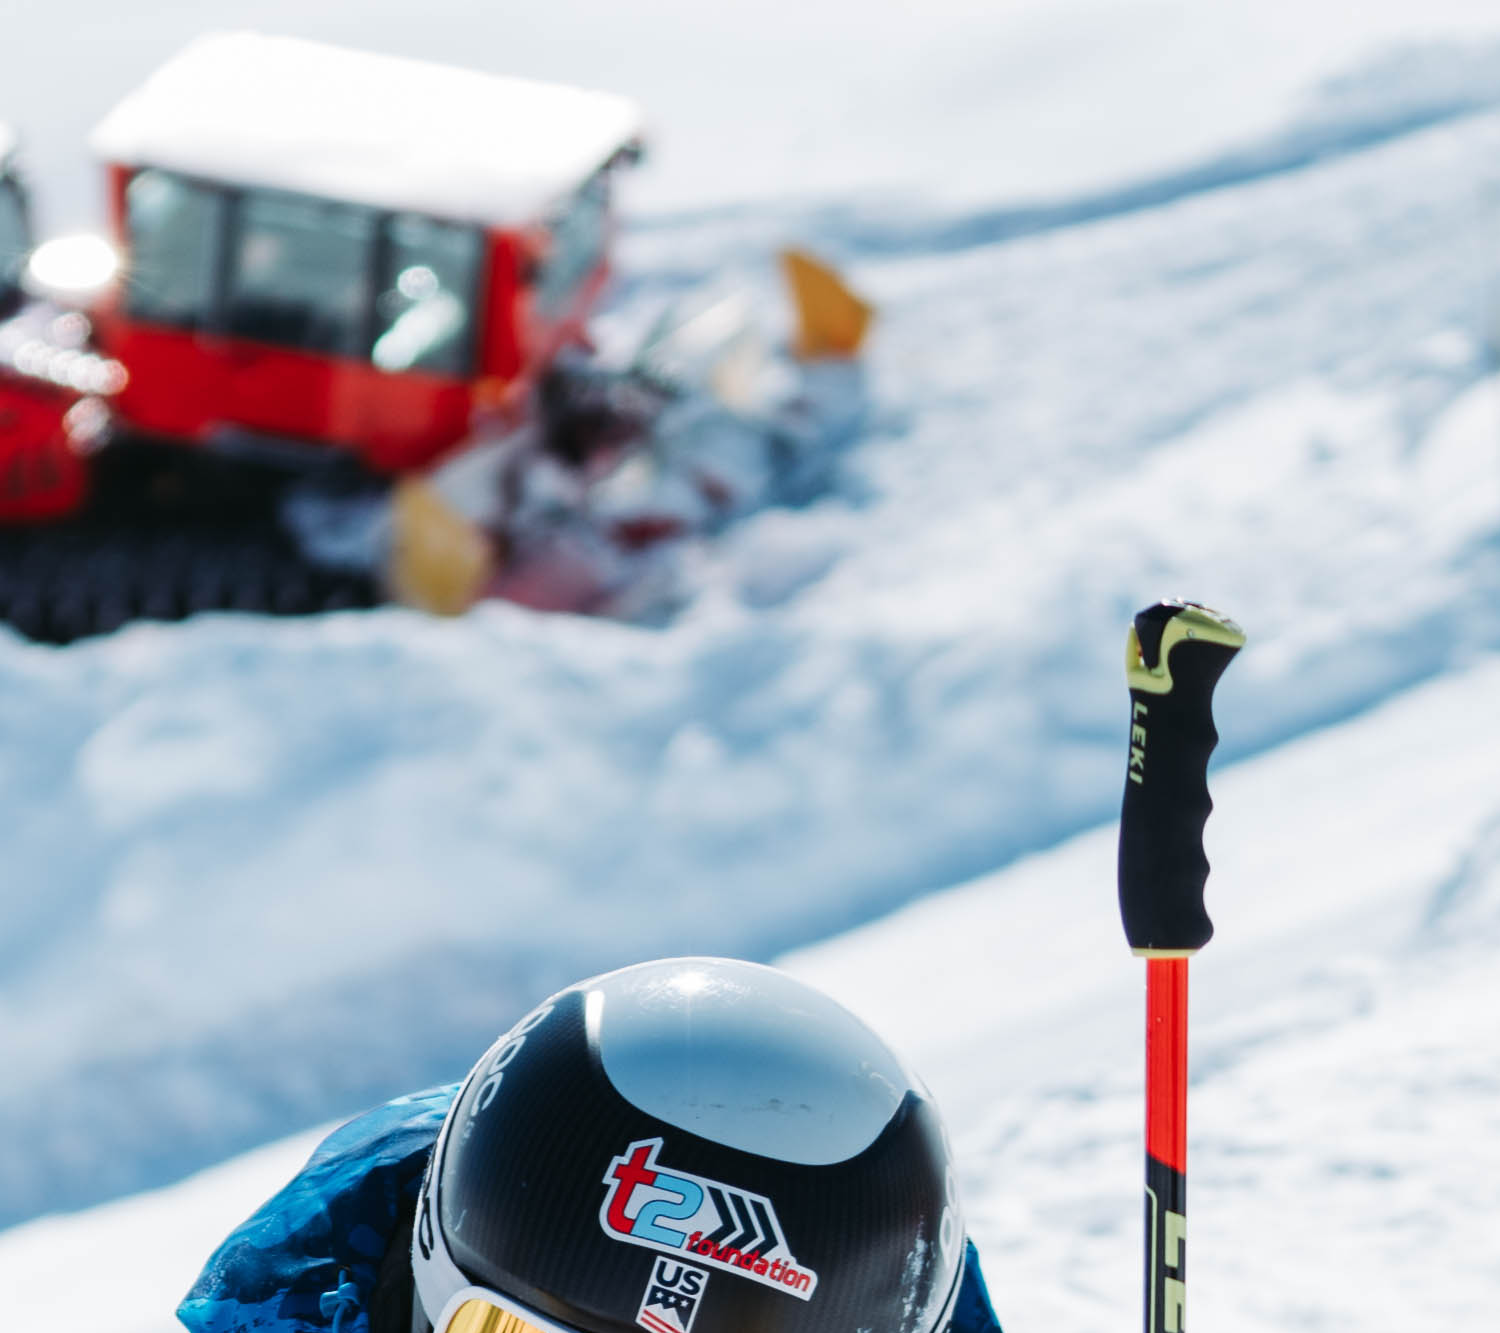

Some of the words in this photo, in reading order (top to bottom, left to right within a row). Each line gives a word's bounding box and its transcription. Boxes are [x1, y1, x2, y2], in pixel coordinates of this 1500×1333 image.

[1129, 700, 1149, 785] LEKI
[606, 1145, 704, 1249] t2
[655, 1260, 704, 1296] US
[685, 1231, 811, 1292] foundation
